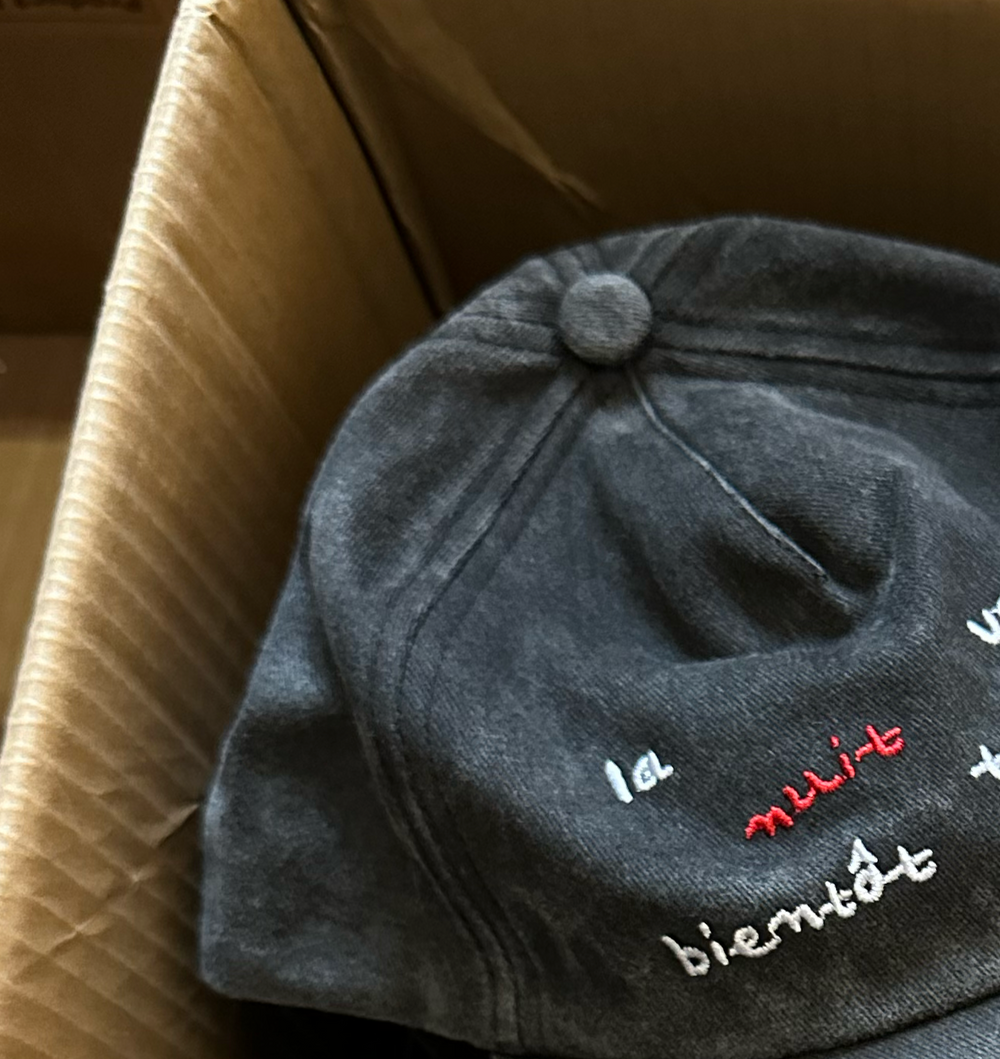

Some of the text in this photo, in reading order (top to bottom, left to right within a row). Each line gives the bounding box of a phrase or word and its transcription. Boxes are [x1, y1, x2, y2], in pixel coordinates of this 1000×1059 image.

[604, 750, 674, 803] la
[745, 724, 905, 840] nuit
[662, 838, 938, 977] bientôt
